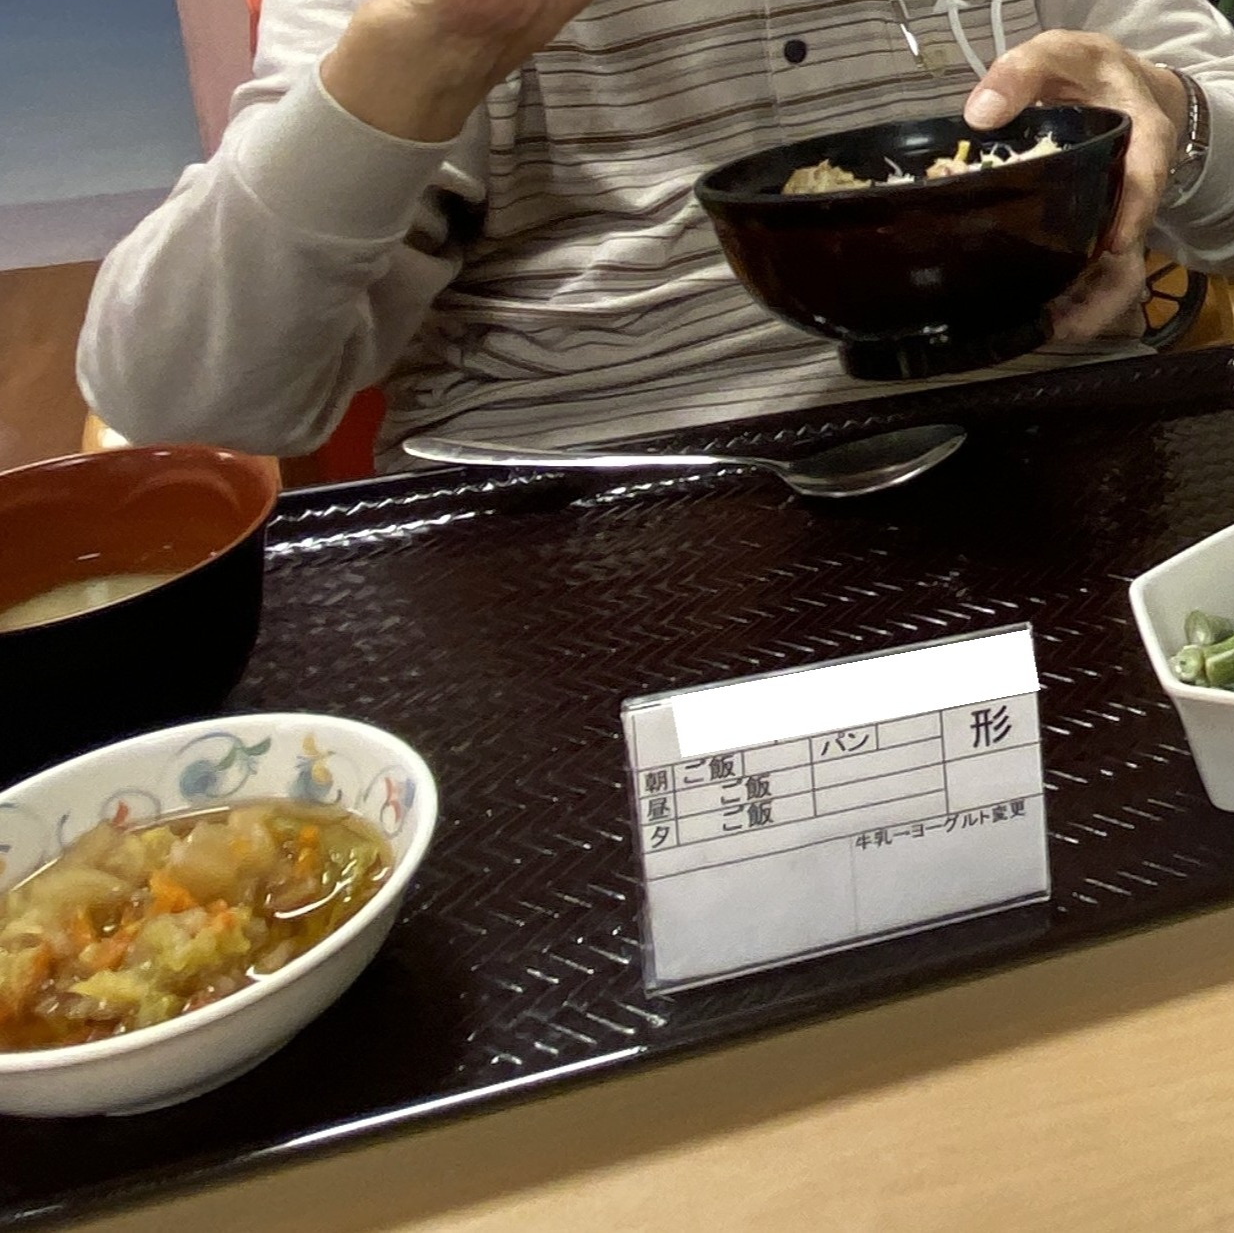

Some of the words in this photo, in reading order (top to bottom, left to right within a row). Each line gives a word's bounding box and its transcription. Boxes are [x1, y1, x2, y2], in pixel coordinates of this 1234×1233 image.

[644, 770, 669, 793] 朝
[683, 753, 736, 785] ご飯
[820, 733, 870, 757] パン
[969, 705, 1012, 749] 形
[647, 796, 670, 822] 昼
[720, 775, 772, 806] ご飯
[722, 801, 775, 833] ご飯
